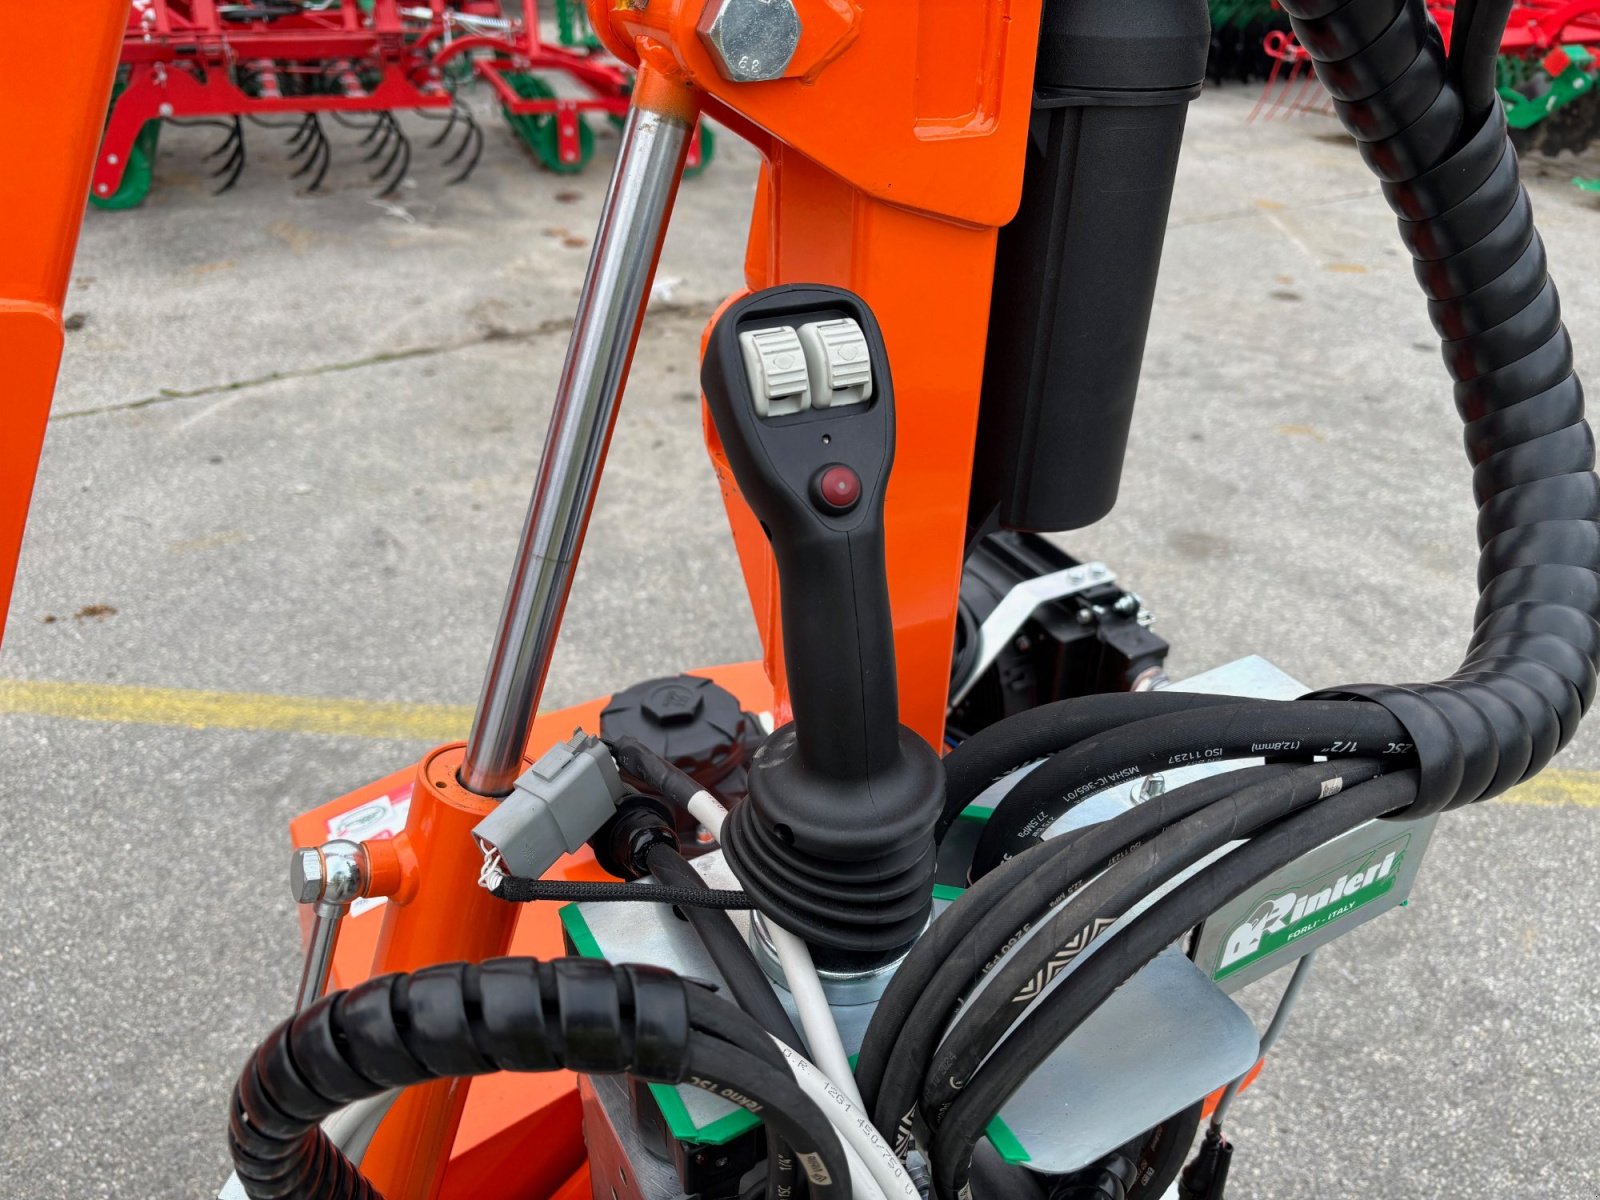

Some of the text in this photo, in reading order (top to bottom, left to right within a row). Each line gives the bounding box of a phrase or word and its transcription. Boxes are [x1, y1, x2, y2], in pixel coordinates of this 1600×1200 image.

[1204, 747, 1223, 758] ISO
[1320, 741, 1358, 753] 1/2"
[1382, 742, 1413, 754] 2SC
[1168, 751, 1201, 764] 11237
[1108, 765, 1140, 781] MSHA
[1062, 777, 1107, 802] IC-365/01
[1017, 811, 1049, 838] 27.5MPa
[1327, 901, 1356, 921] ITALY
